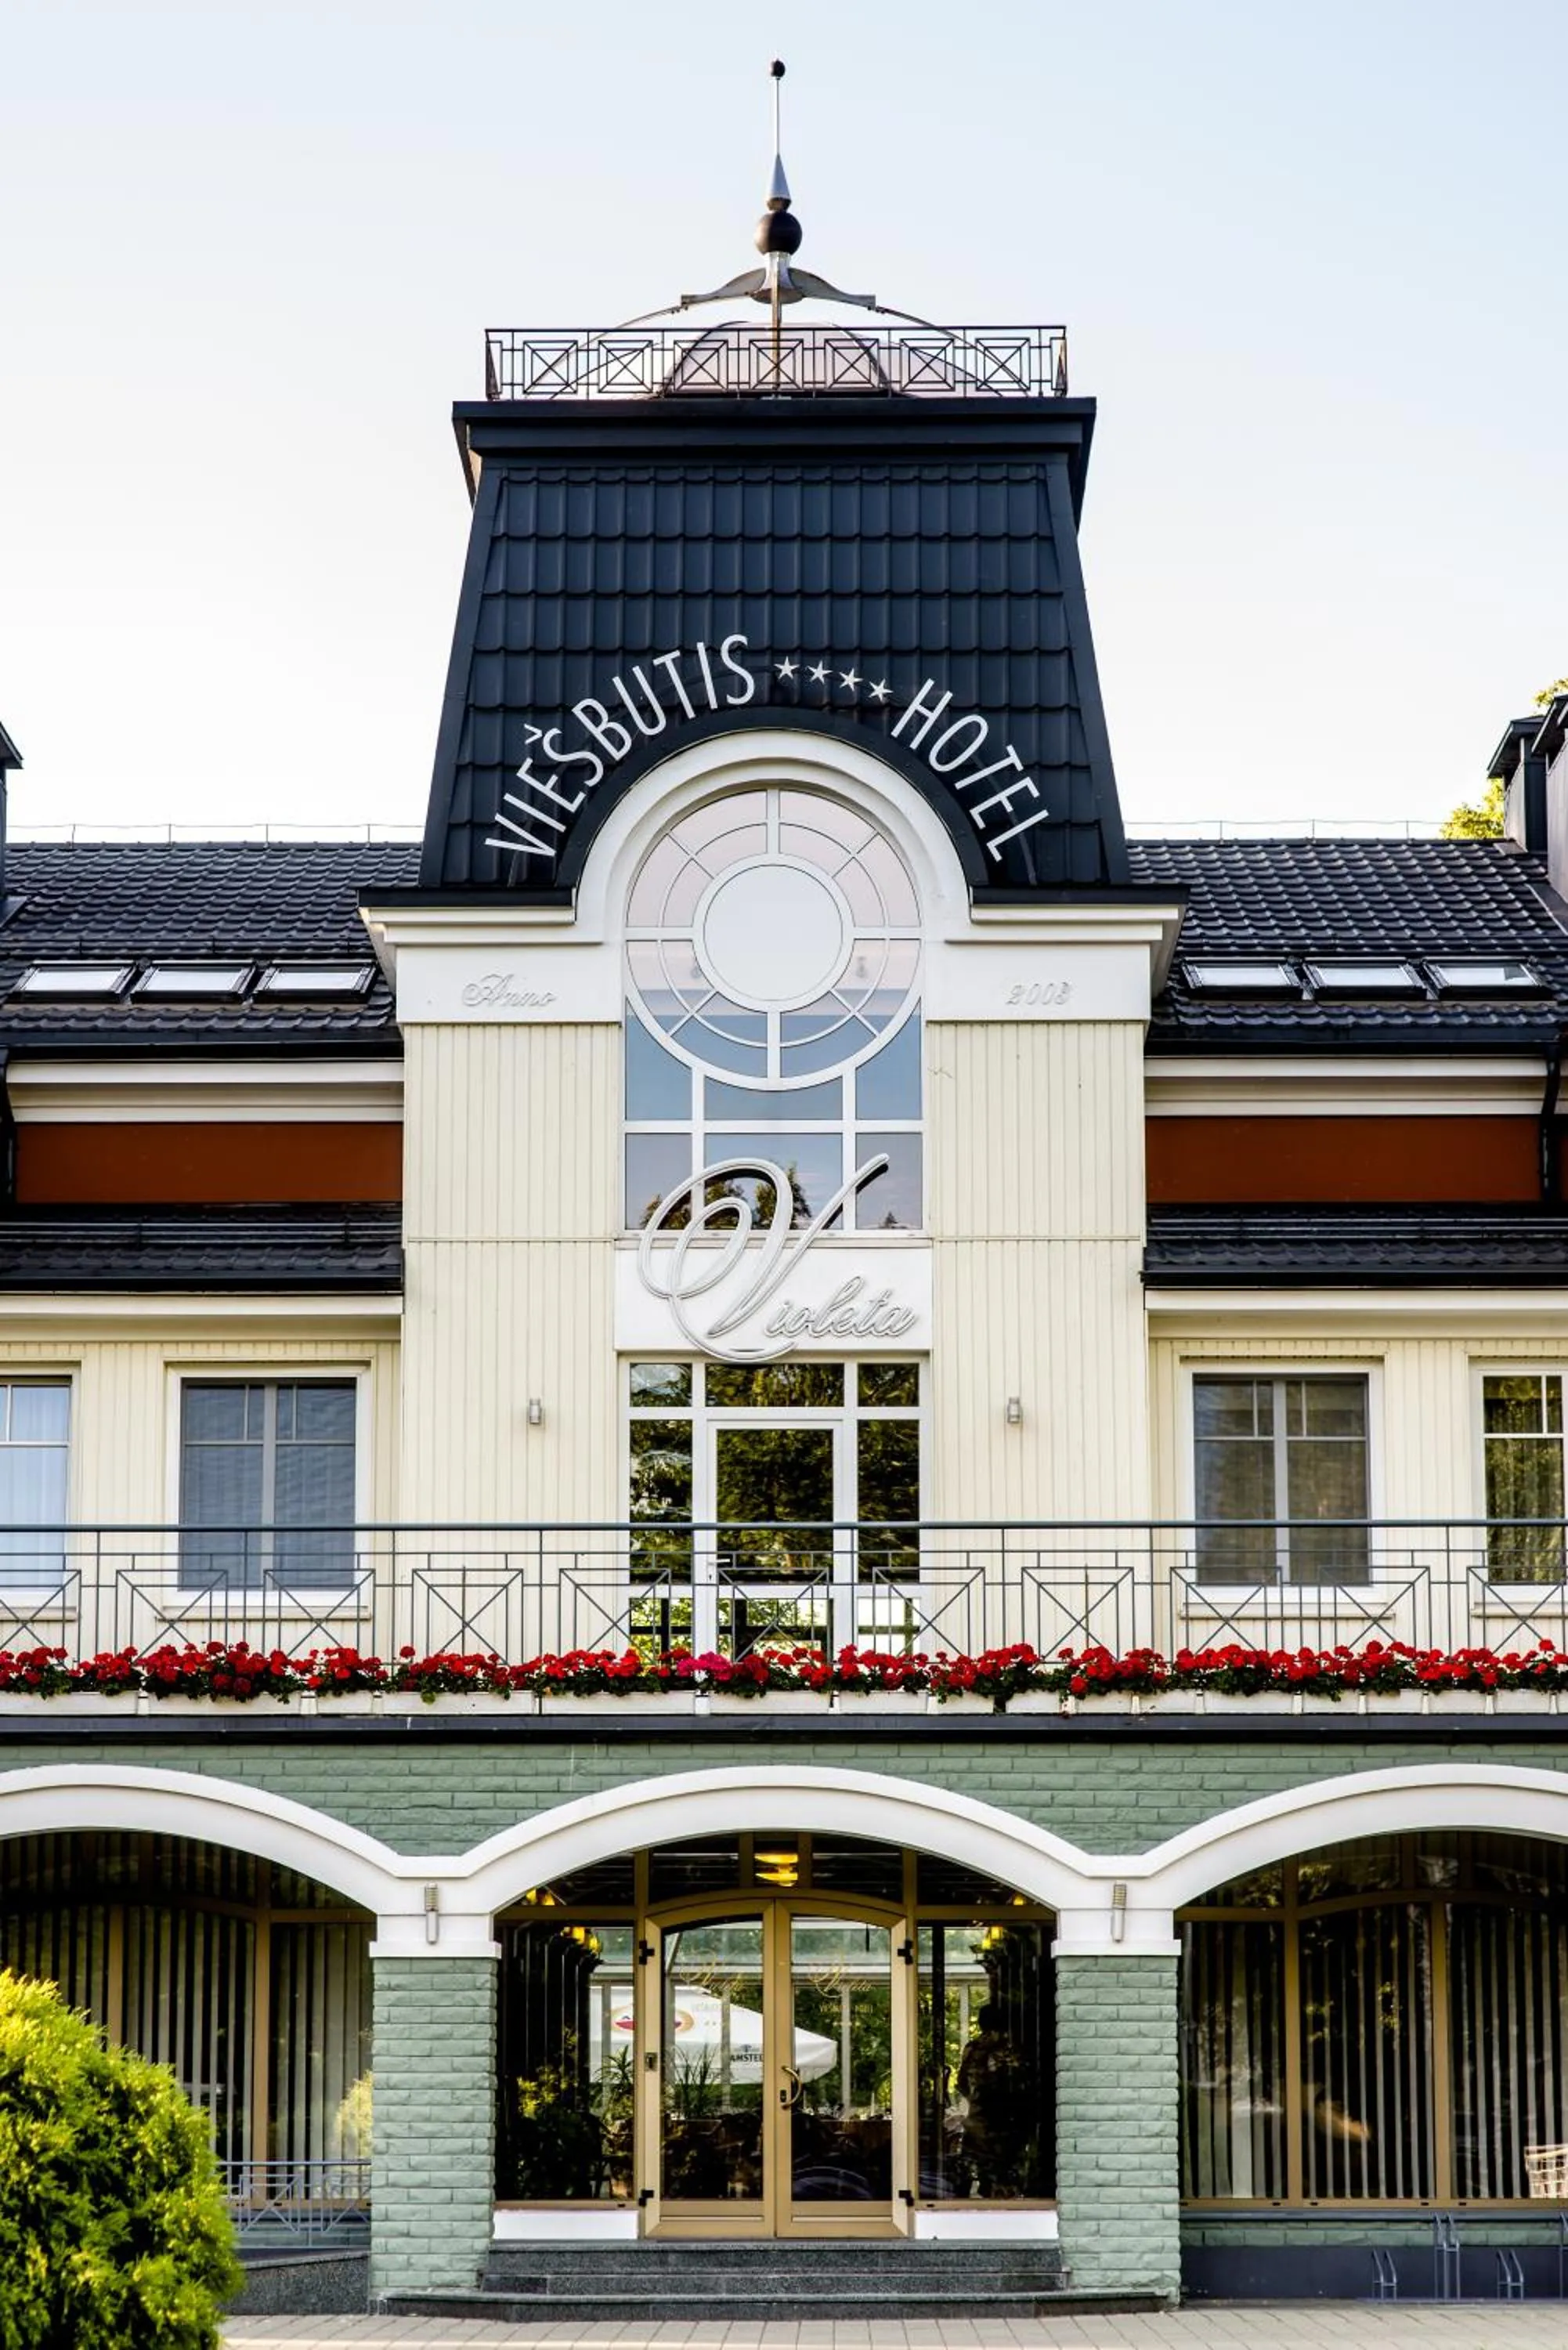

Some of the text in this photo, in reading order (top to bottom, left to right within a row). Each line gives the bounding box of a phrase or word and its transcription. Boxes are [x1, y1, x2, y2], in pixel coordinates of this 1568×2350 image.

[485, 634, 1050, 862] VIEŠBUTIS HOTEL
[462, 974, 557, 1007] Anno
[638, 1153, 916, 1361] Violeta
